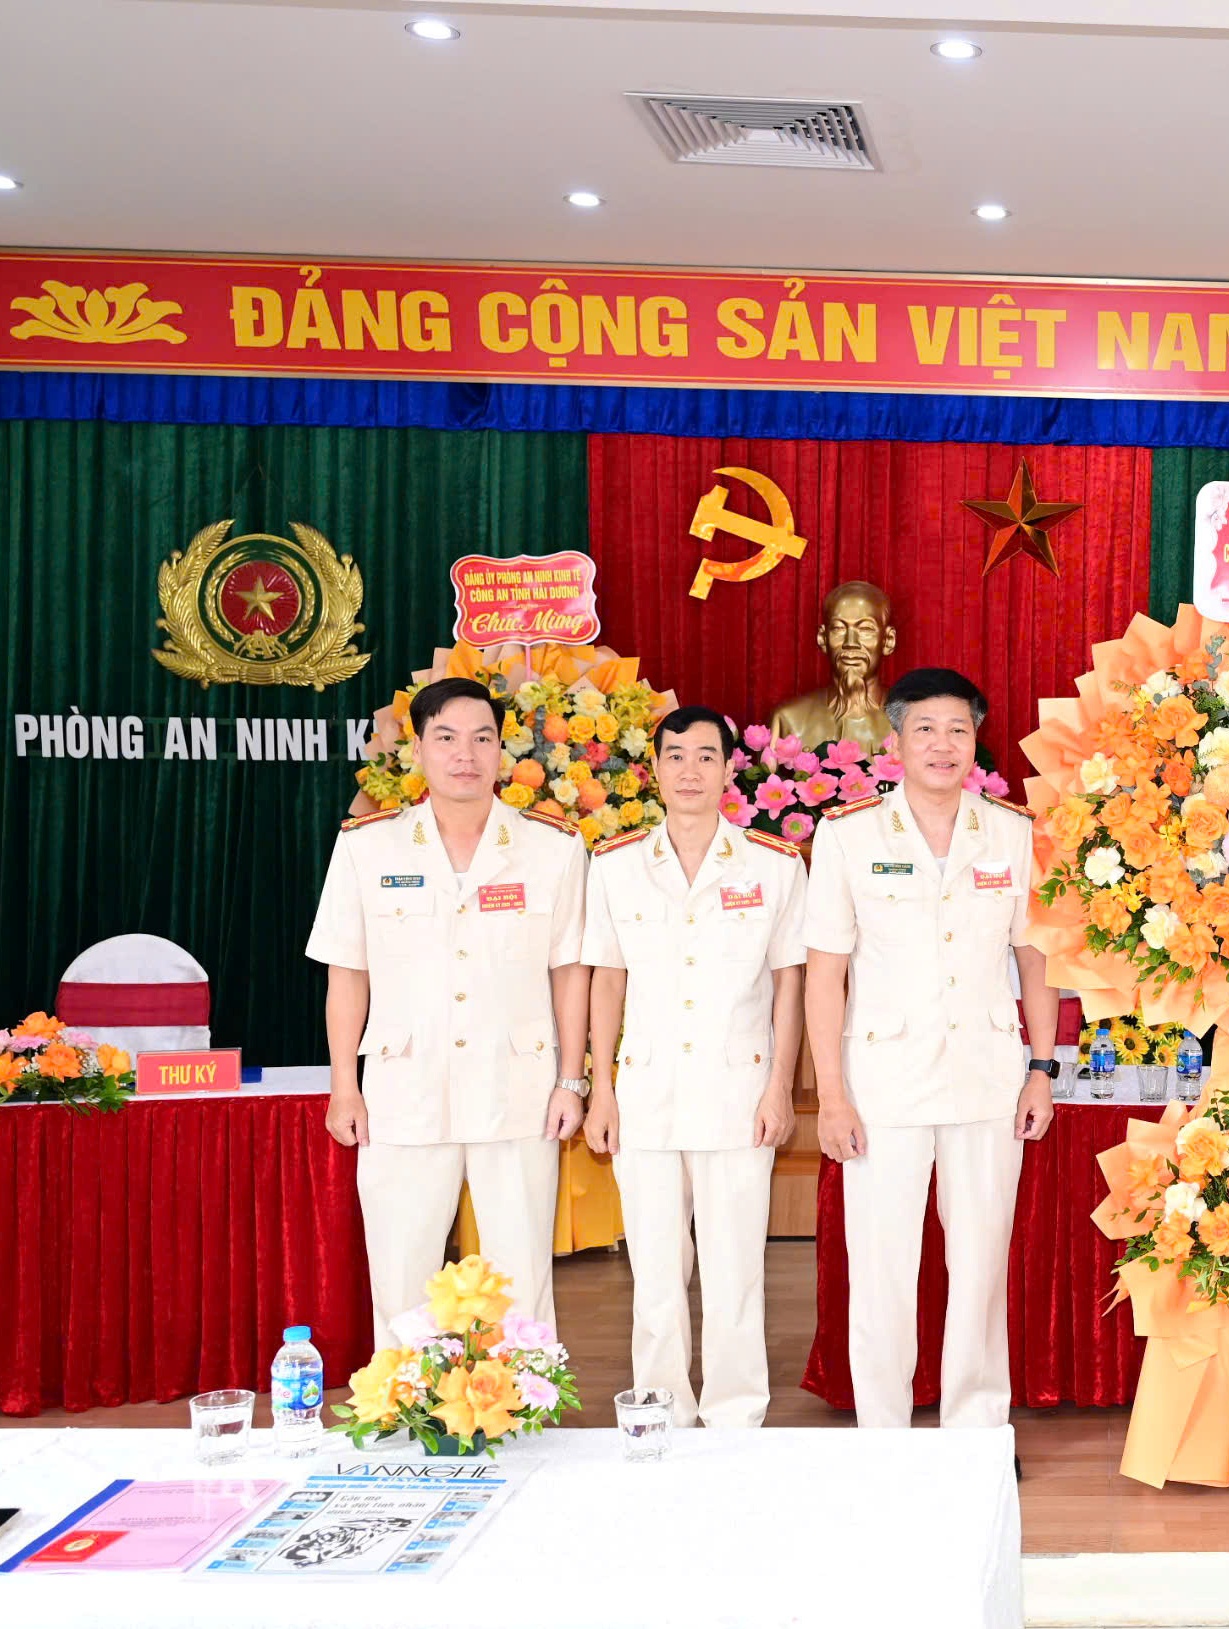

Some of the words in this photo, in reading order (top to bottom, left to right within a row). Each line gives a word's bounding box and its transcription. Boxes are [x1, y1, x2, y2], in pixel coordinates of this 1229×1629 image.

[231, 265, 451, 351] ĐẢNG
[480, 279, 688, 367] CỘNG
[718, 278, 876, 362] SẢN
[909, 294, 1066, 379] VIỆT
[464, 568, 485, 586] ĐẢNG
[497, 568, 521, 584] PHÒNG
[523, 571, 533, 582] AN
[535, 570, 552, 582] NINH
[554, 569, 571, 582] KINH
[470, 586, 494, 602] CÔNG
[497, 589, 509, 601] AN
[550, 585, 580, 599] DƯƠNG
[469, 611, 521, 634] Chúc
[14, 706, 144, 760] PHÒNG
[163, 716, 217, 761] AN
[235, 717, 328, 762] NINH
[158, 1063, 191, 1085] THƯ
[195, 1060, 217, 1084] KÝ
